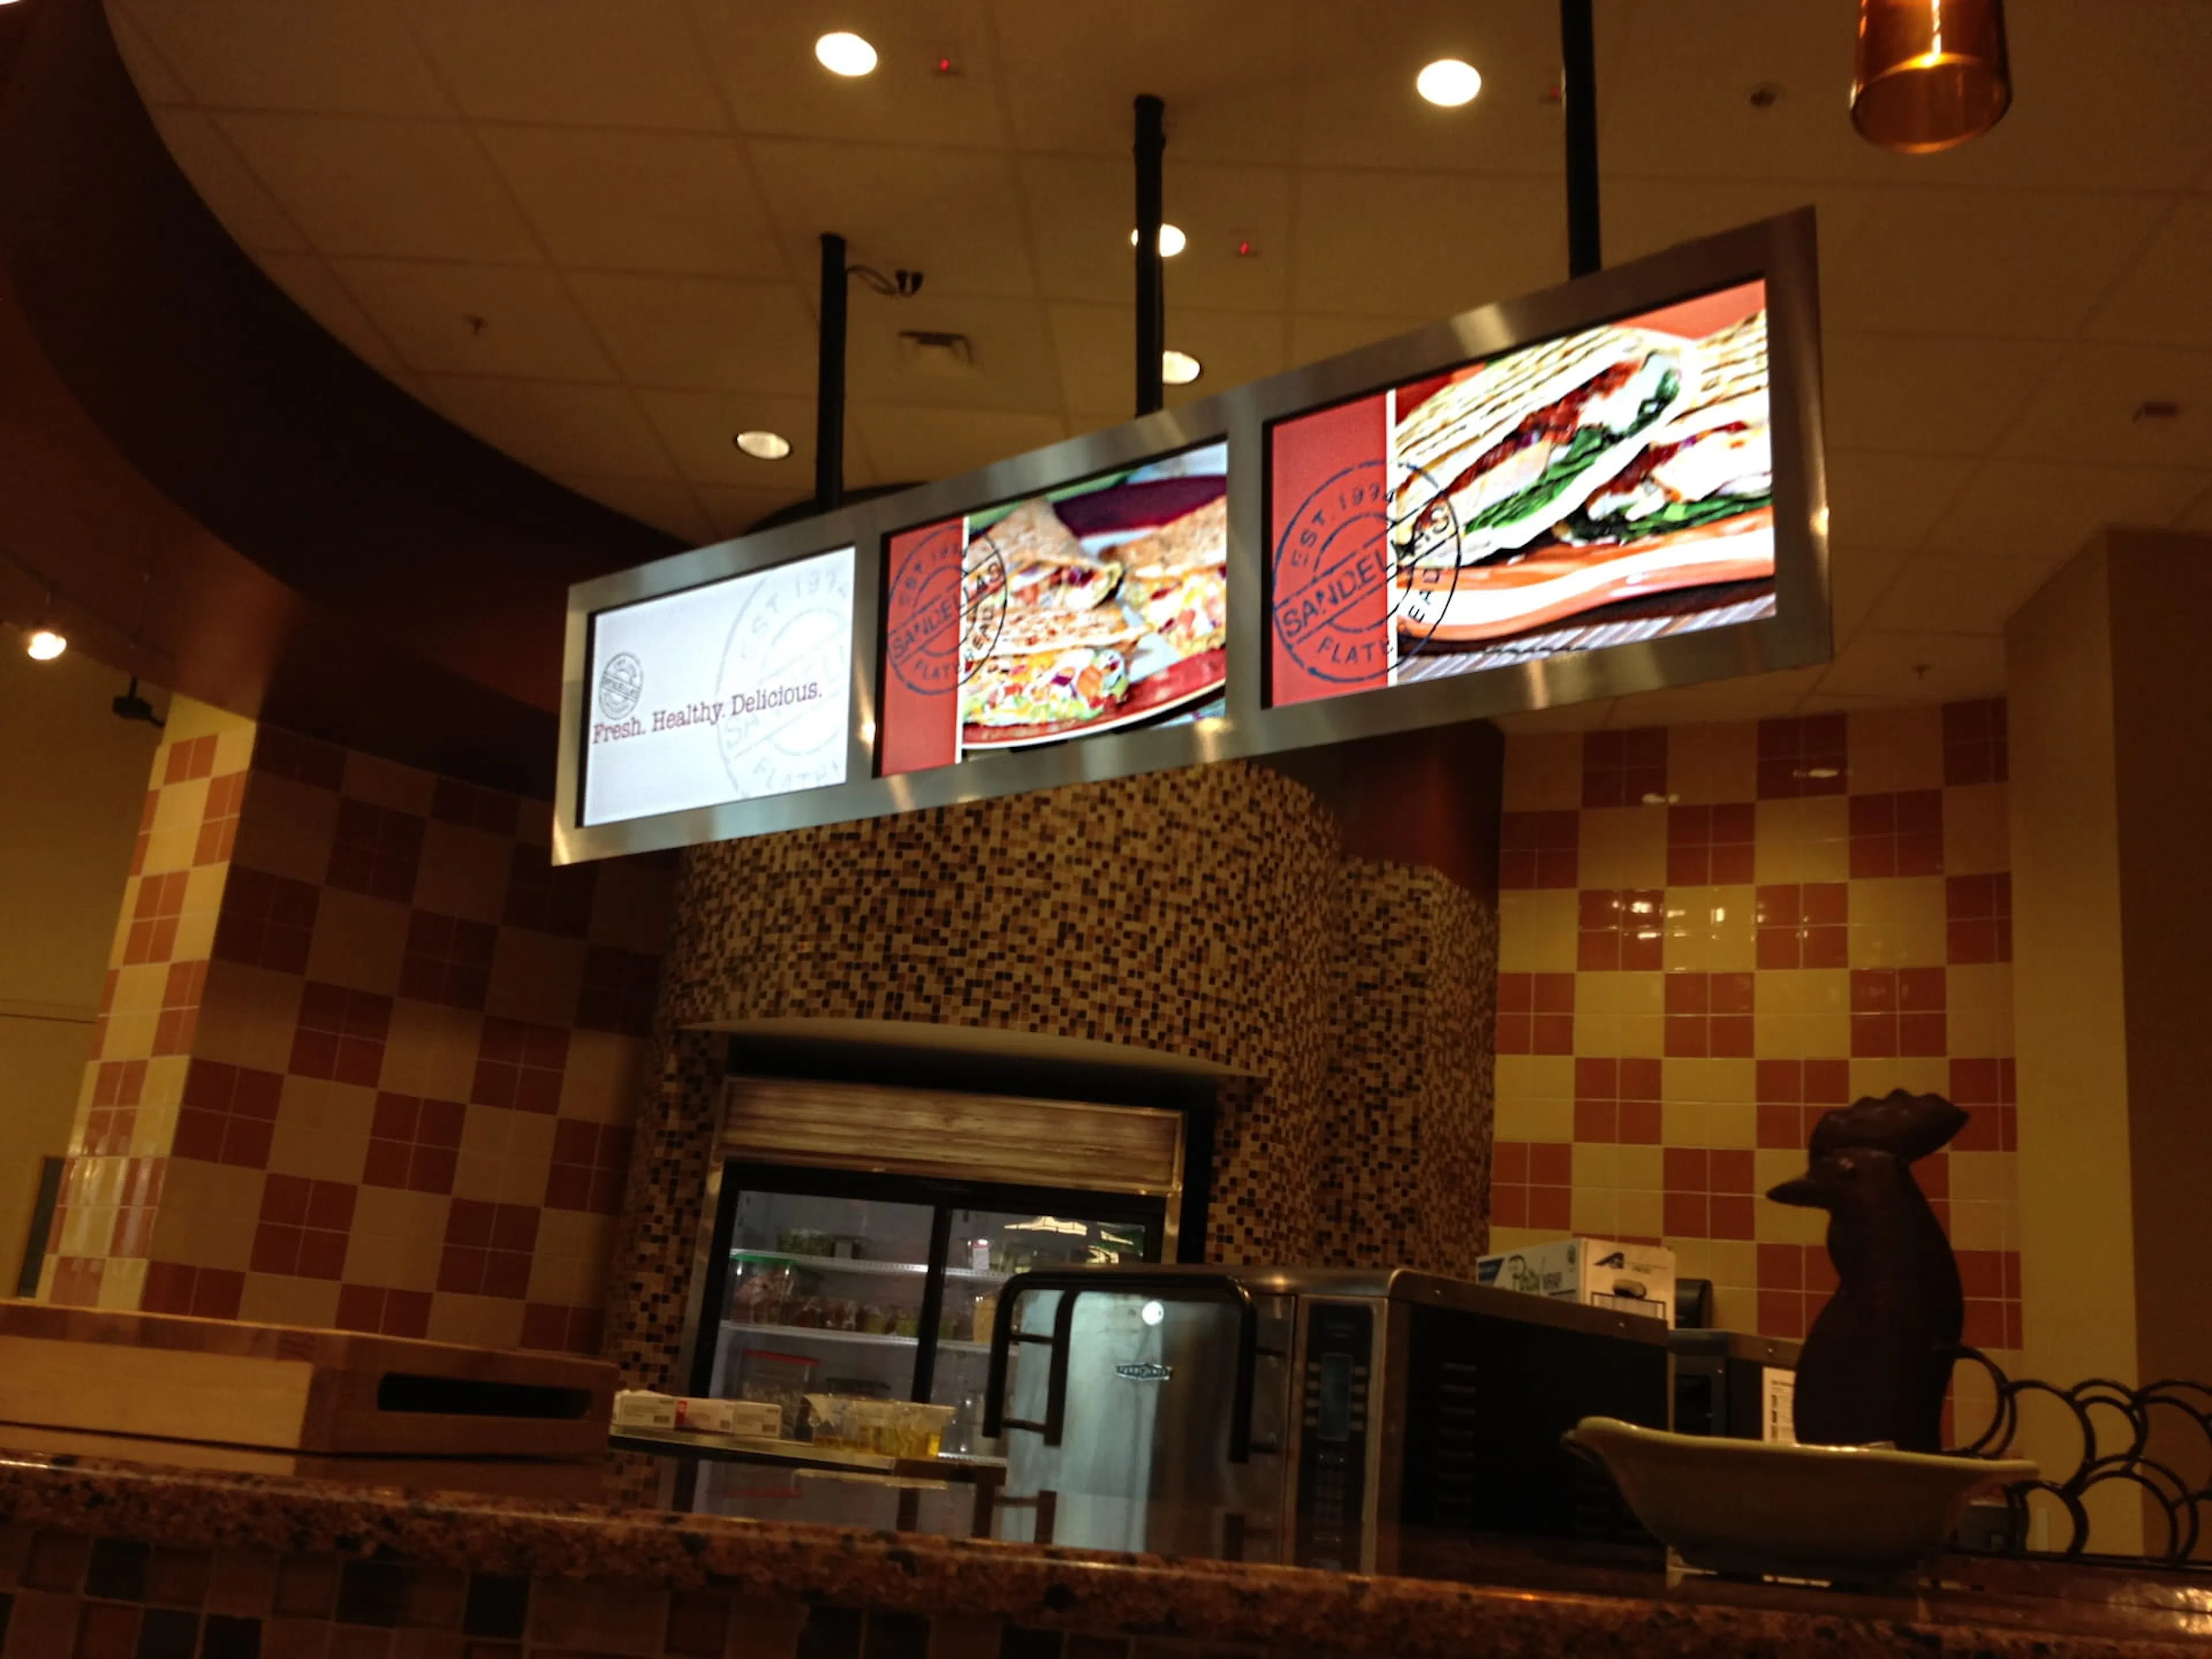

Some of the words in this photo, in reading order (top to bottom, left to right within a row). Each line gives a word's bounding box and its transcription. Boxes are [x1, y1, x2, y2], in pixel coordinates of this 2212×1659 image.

[592, 717, 647, 744] Fresh.
[652, 702, 726, 733] Healthy.
[731, 681, 823, 717] Delicious.
